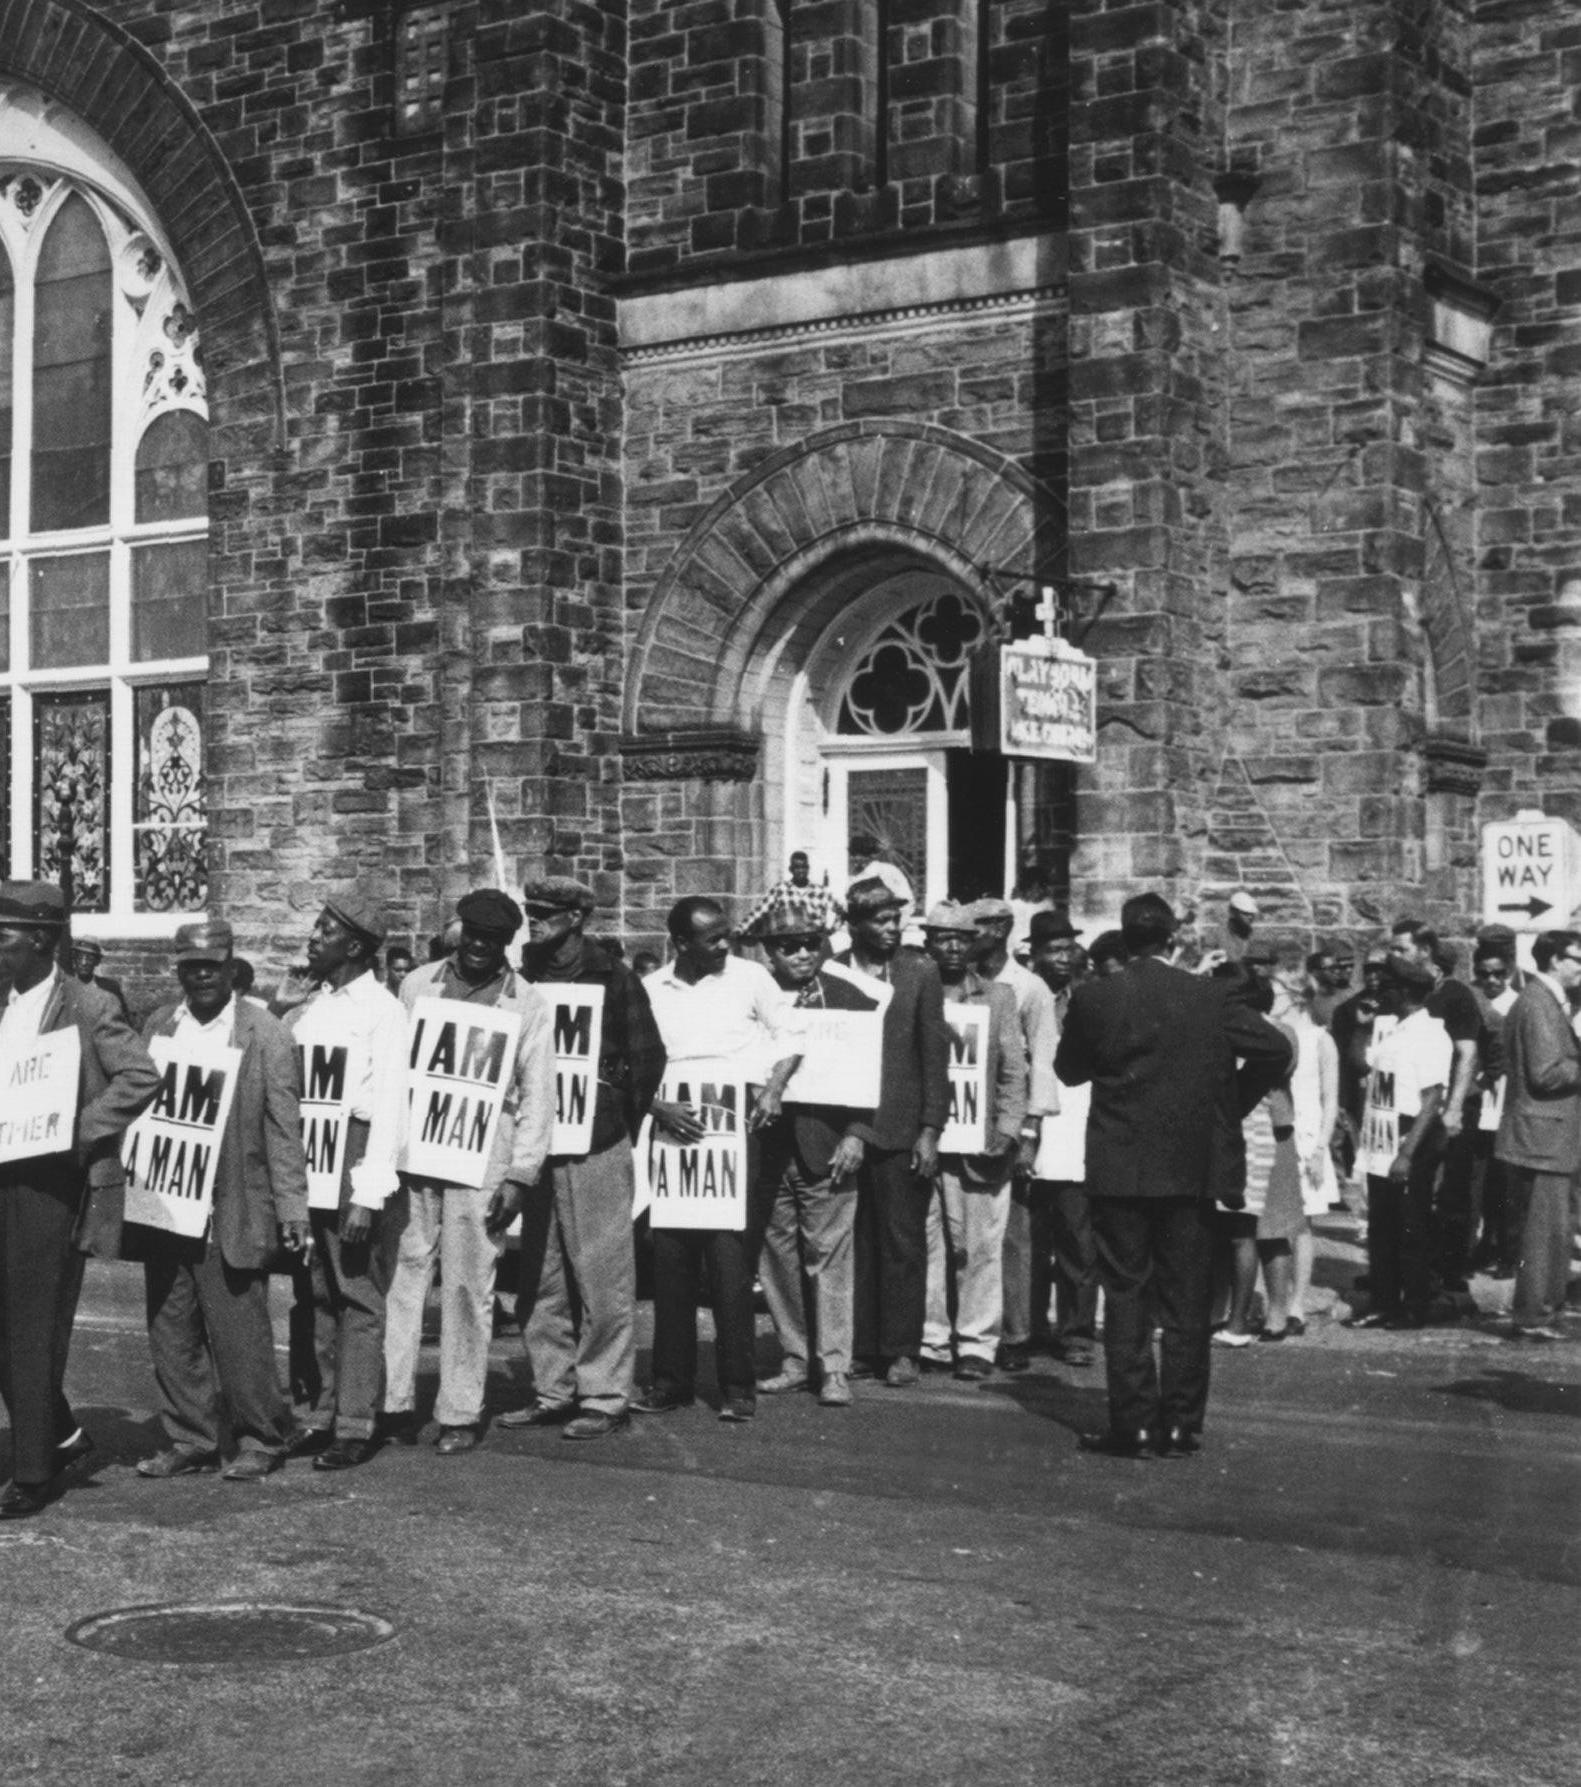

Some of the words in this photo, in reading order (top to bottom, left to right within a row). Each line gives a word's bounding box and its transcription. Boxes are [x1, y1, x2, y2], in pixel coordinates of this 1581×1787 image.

[1498, 833, 1553, 858] ONE
[1498, 864, 1553, 888] WAY
[410, 1018, 426, 1070] I
[427, 1021, 509, 1084] AM
[554, 1004, 593, 1056] M
[9, 1052, 53, 1088] ARE
[143, 1061, 227, 1125] AM
[300, 1117, 340, 1175] AN
[421, 1090, 494, 1153] MAN
[144, 1134, 212, 1201] MAN
[657, 1149, 669, 1198] A
[679, 1148, 737, 1199] MAN
